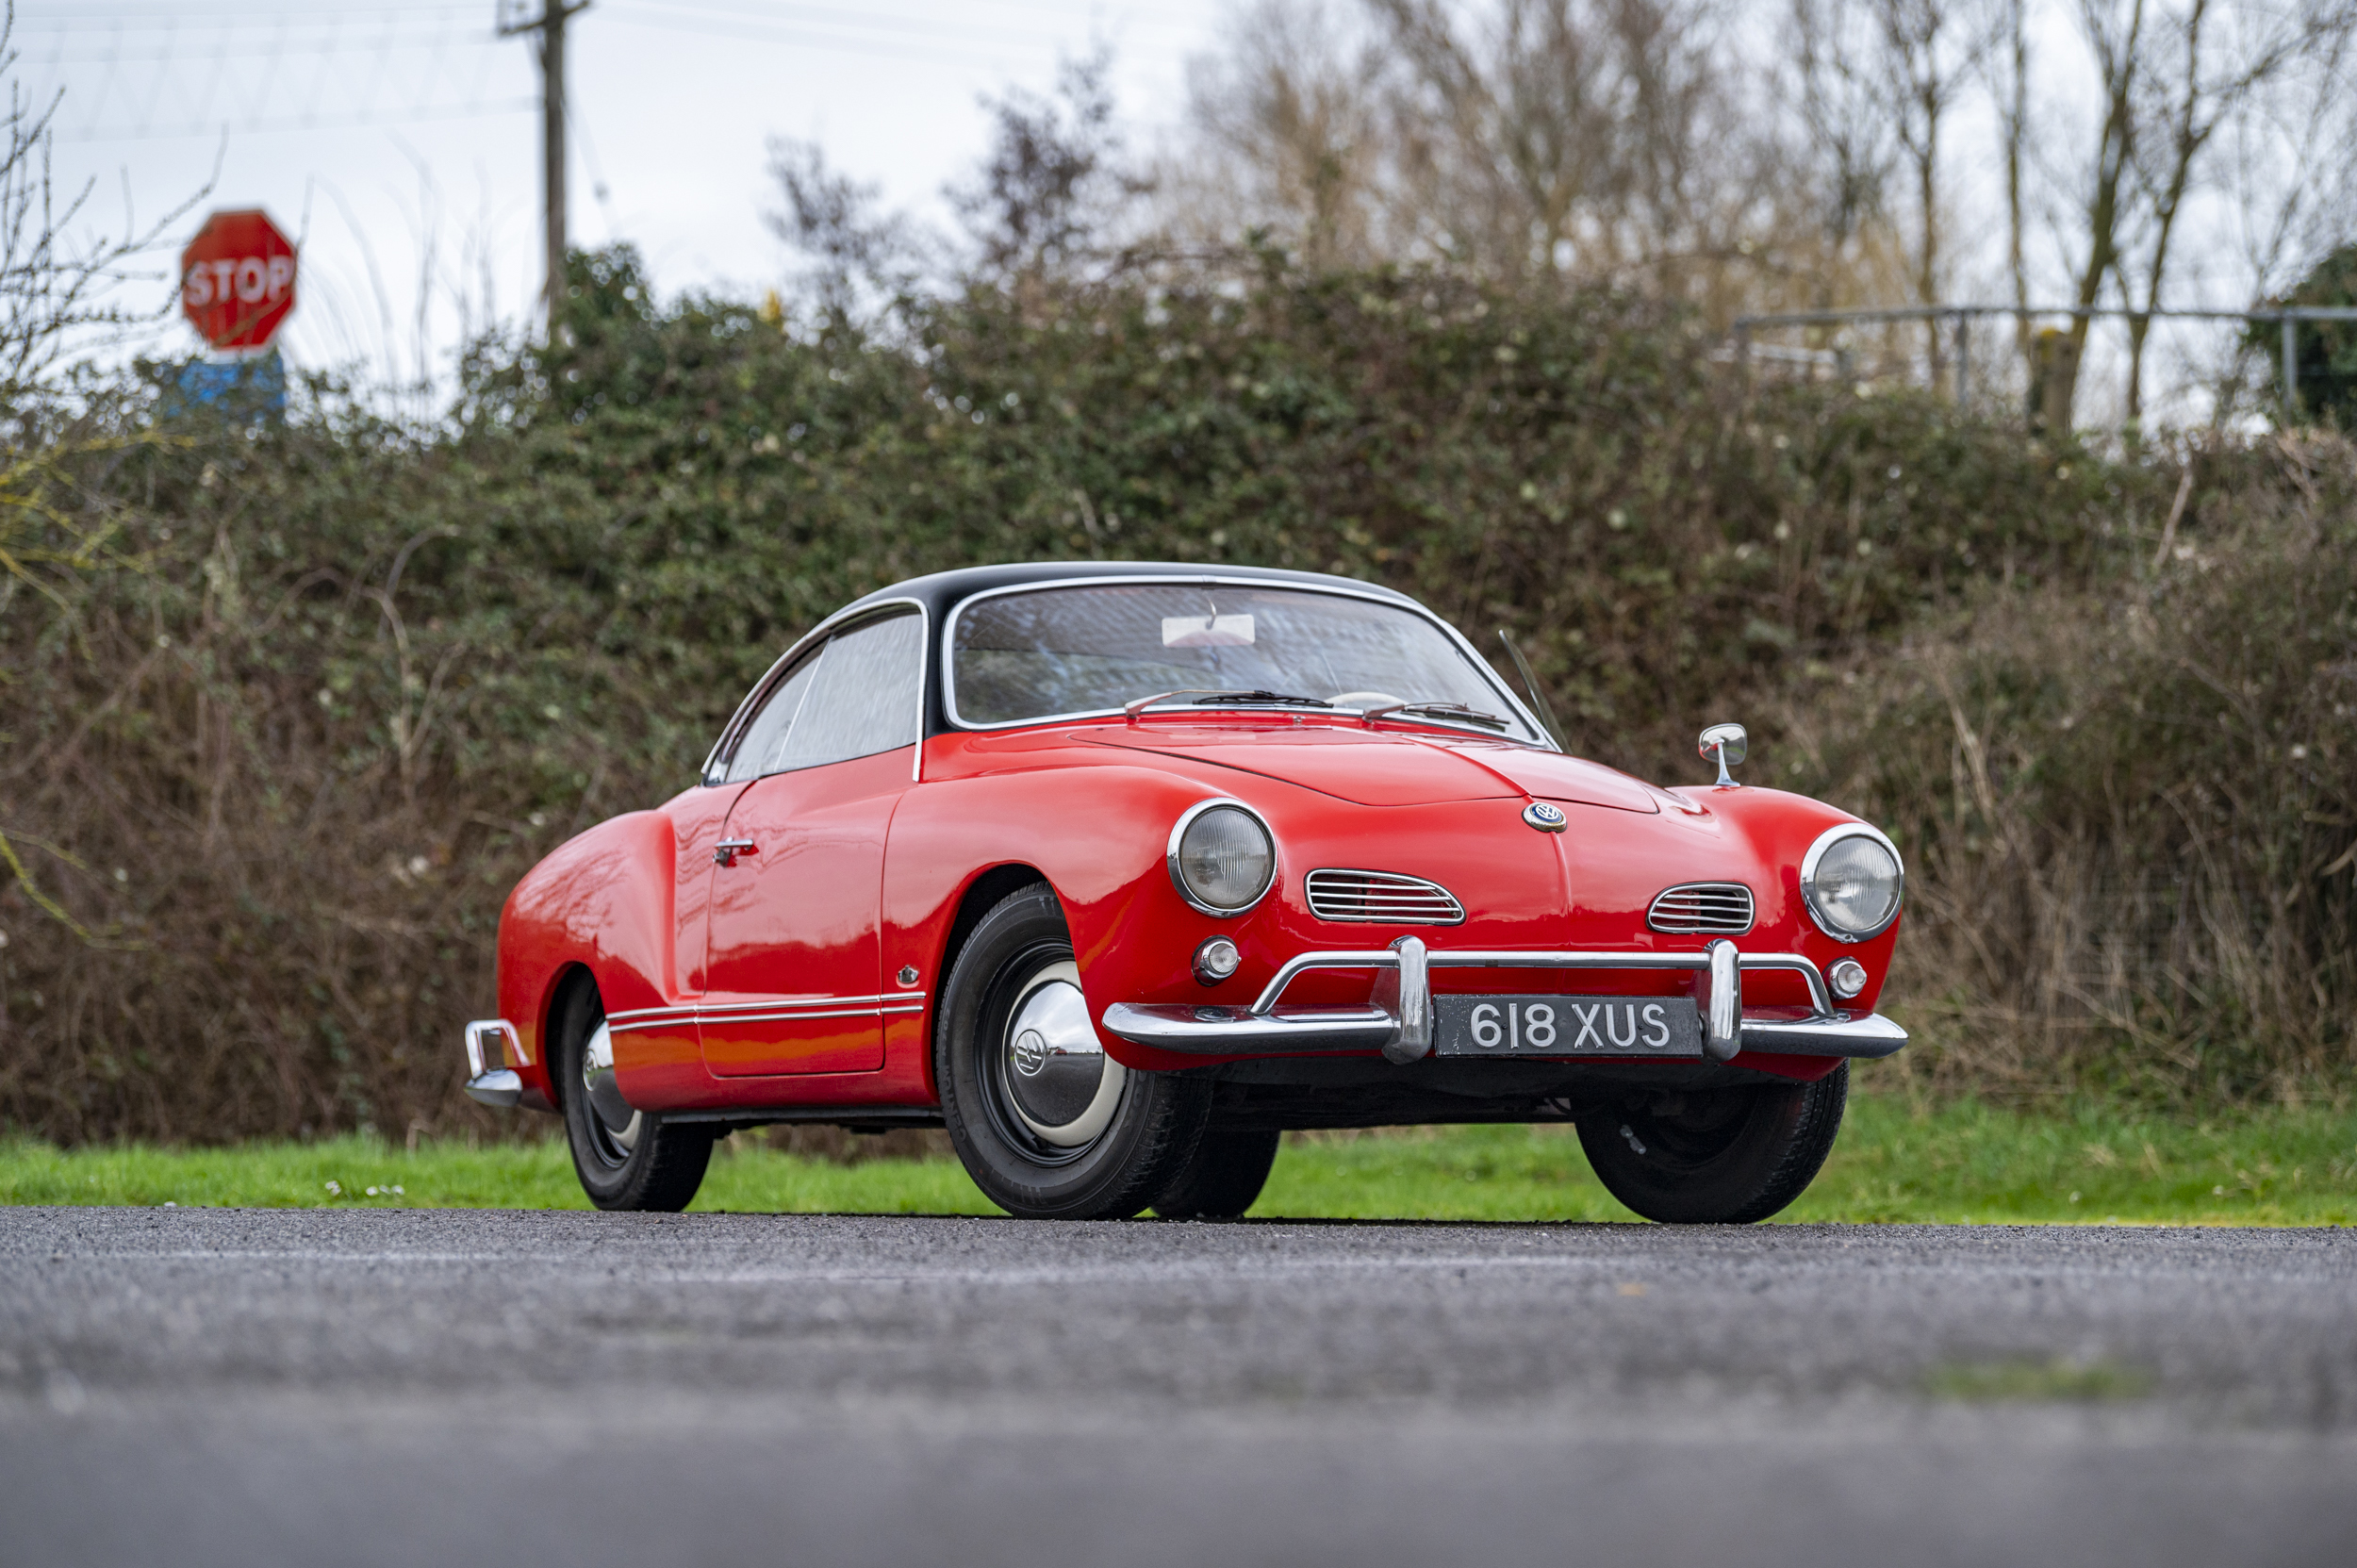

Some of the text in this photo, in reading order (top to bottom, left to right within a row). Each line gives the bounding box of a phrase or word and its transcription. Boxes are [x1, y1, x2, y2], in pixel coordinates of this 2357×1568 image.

[186, 256, 294, 306] STOP
[1470, 1002, 1671, 1049] 618 XUS
